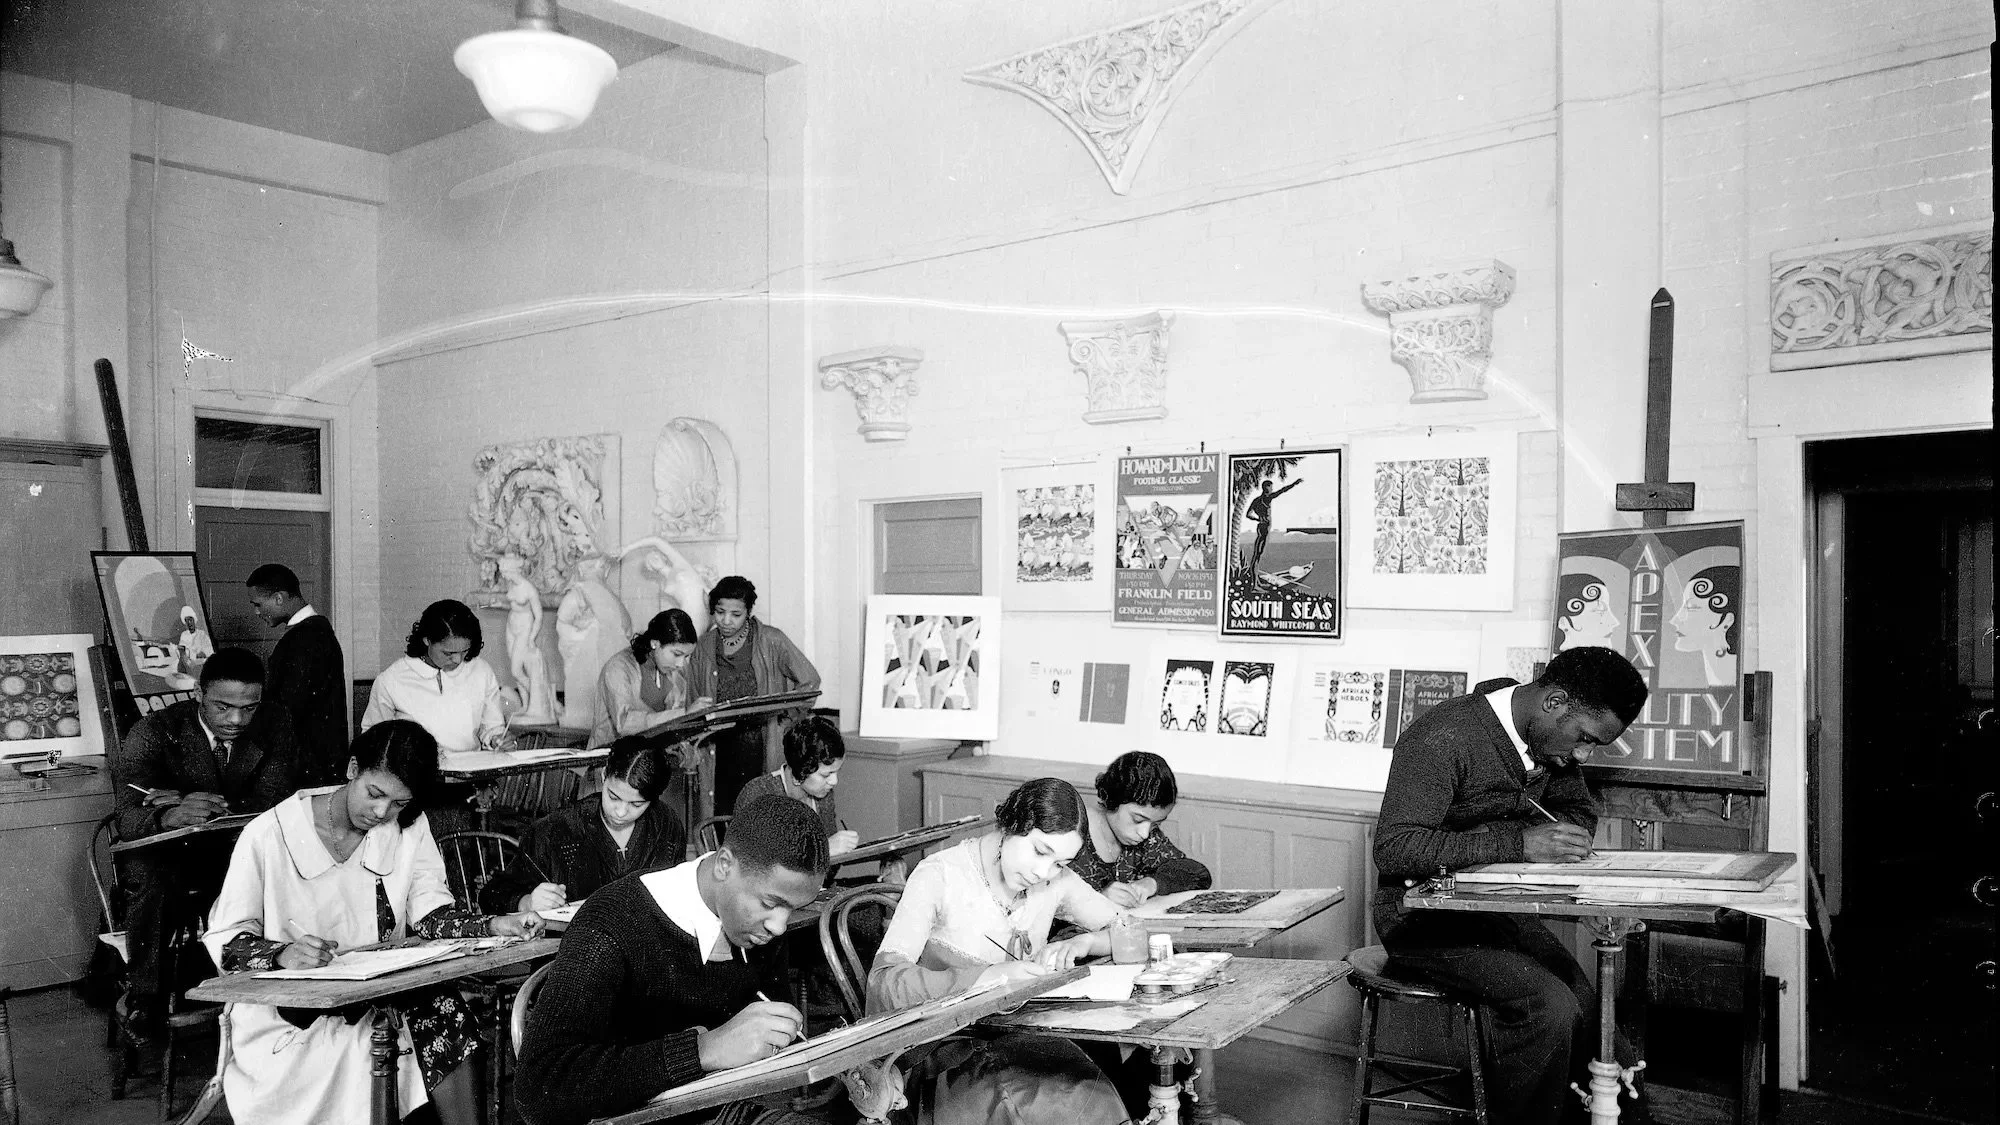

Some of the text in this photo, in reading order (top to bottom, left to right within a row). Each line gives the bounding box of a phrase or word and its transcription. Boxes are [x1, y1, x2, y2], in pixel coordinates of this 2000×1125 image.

[1120, 458, 1165, 475] HOWARD
[1169, 456, 1216, 473] LINCOLN
[1133, 475, 1202, 485] FOOTBALL CLASSIC
[1119, 571, 1154, 580] THURSDAY
[1118, 588, 1213, 600] FRANKLIN FIELD
[1118, 606, 1154, 615] GENERAL
[1158, 607, 1200, 616] ADMISSION
[1230, 600, 1333, 620] SOUTH SEAS
[1630, 543, 1660, 667] APEX
[1230, 619, 1332, 631] RAYMOND WHITCOMB CO.
[1341, 687, 1371, 695] AFRICAN
[1418, 690, 1450, 699] AFRICAN
[1418, 698, 1442, 706] HERO
[1632, 693, 1733, 725] UTY
[1603, 727, 1733, 762] STEM
